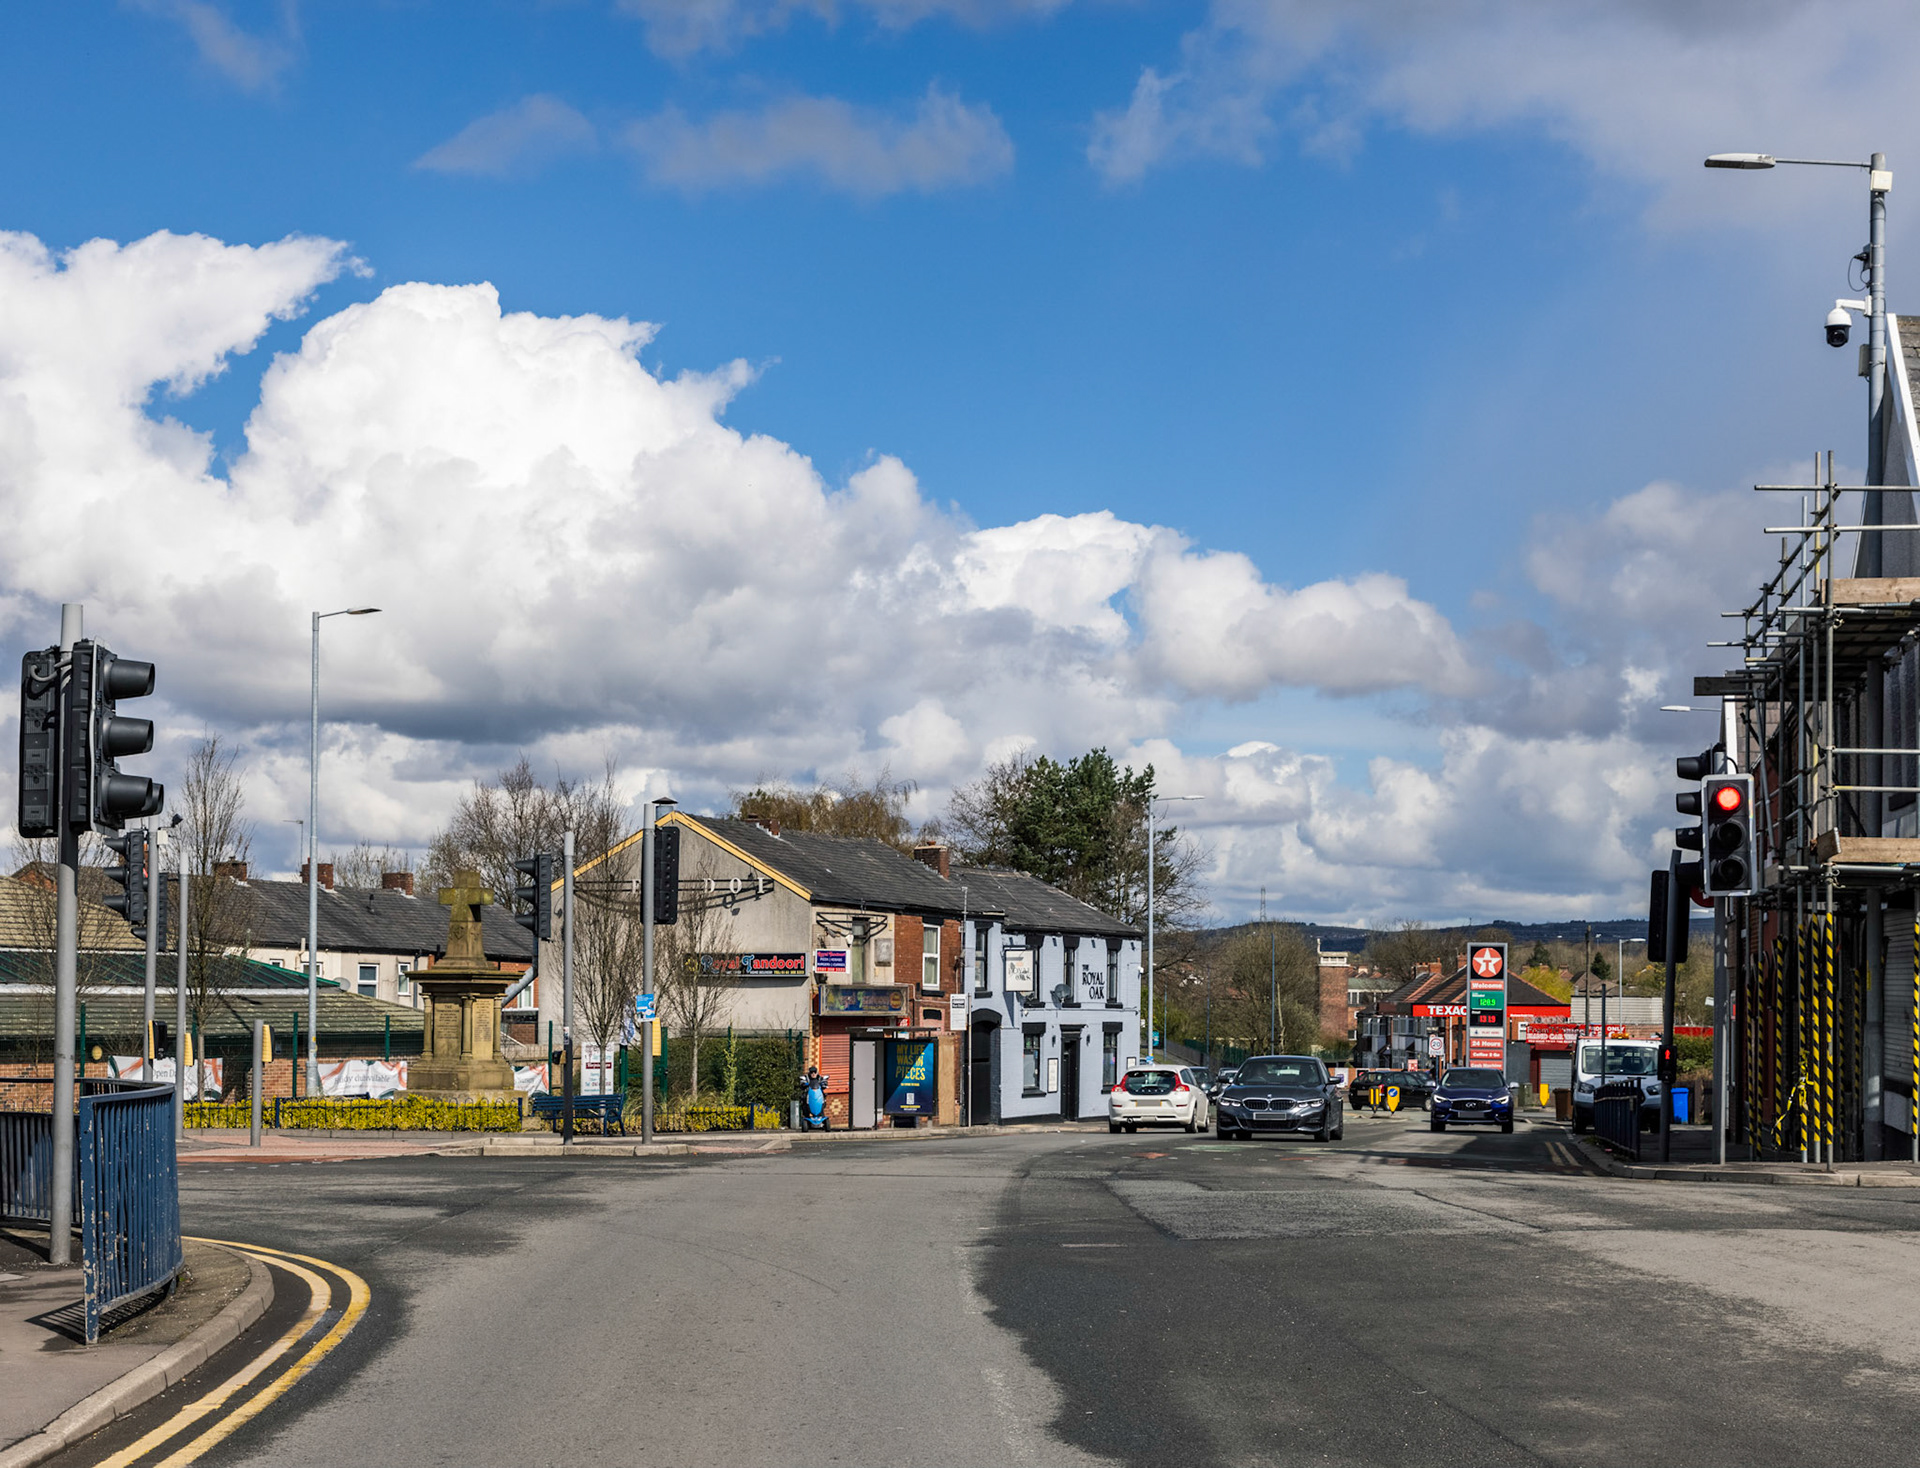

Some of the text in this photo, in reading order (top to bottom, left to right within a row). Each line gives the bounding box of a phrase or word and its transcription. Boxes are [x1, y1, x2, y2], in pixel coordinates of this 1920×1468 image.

[700, 954, 805, 974] Royal Tandoori
[1082, 972, 1105, 985] ROYAL
[1089, 986, 1105, 1000] OAK
[1427, 1005, 1467, 1016] TEXAC
[897, 1045, 925, 1055] MY LIFE
[897, 1055, 914, 1066] WAS
[895, 1066, 926, 1081] PIECES
